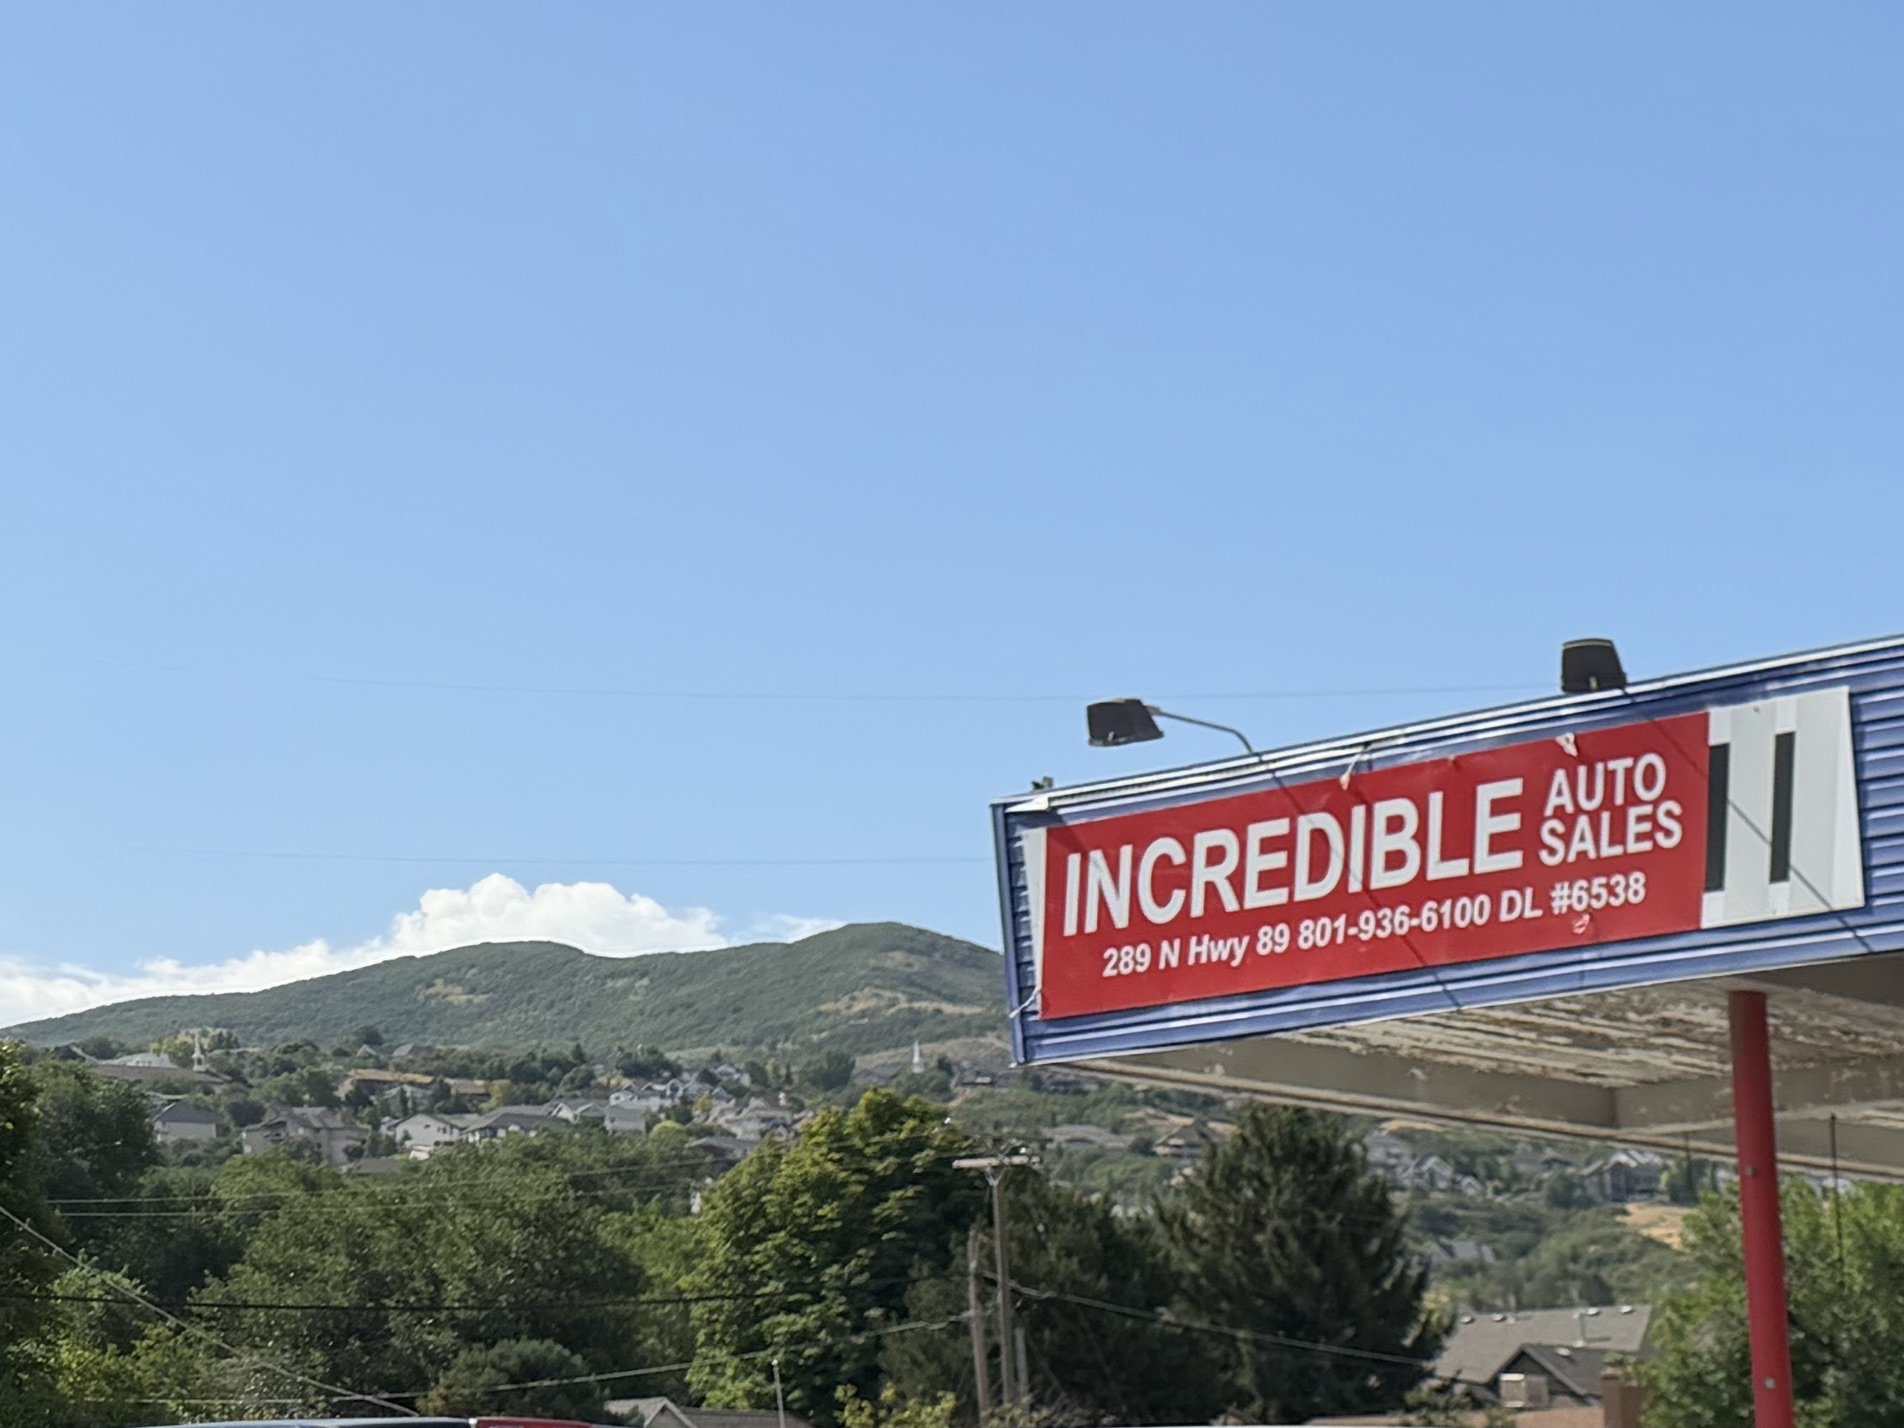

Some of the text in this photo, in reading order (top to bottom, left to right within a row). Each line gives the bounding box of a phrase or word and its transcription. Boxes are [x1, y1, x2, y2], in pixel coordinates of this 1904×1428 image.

[1544, 753, 1666, 816] AUTO
[1063, 778, 1523, 936] INCREDIBLE
[1538, 800, 1683, 867] SALES
[1102, 871, 1647, 977] 289 N Hwy 89 801-936-6100 DL #6538
